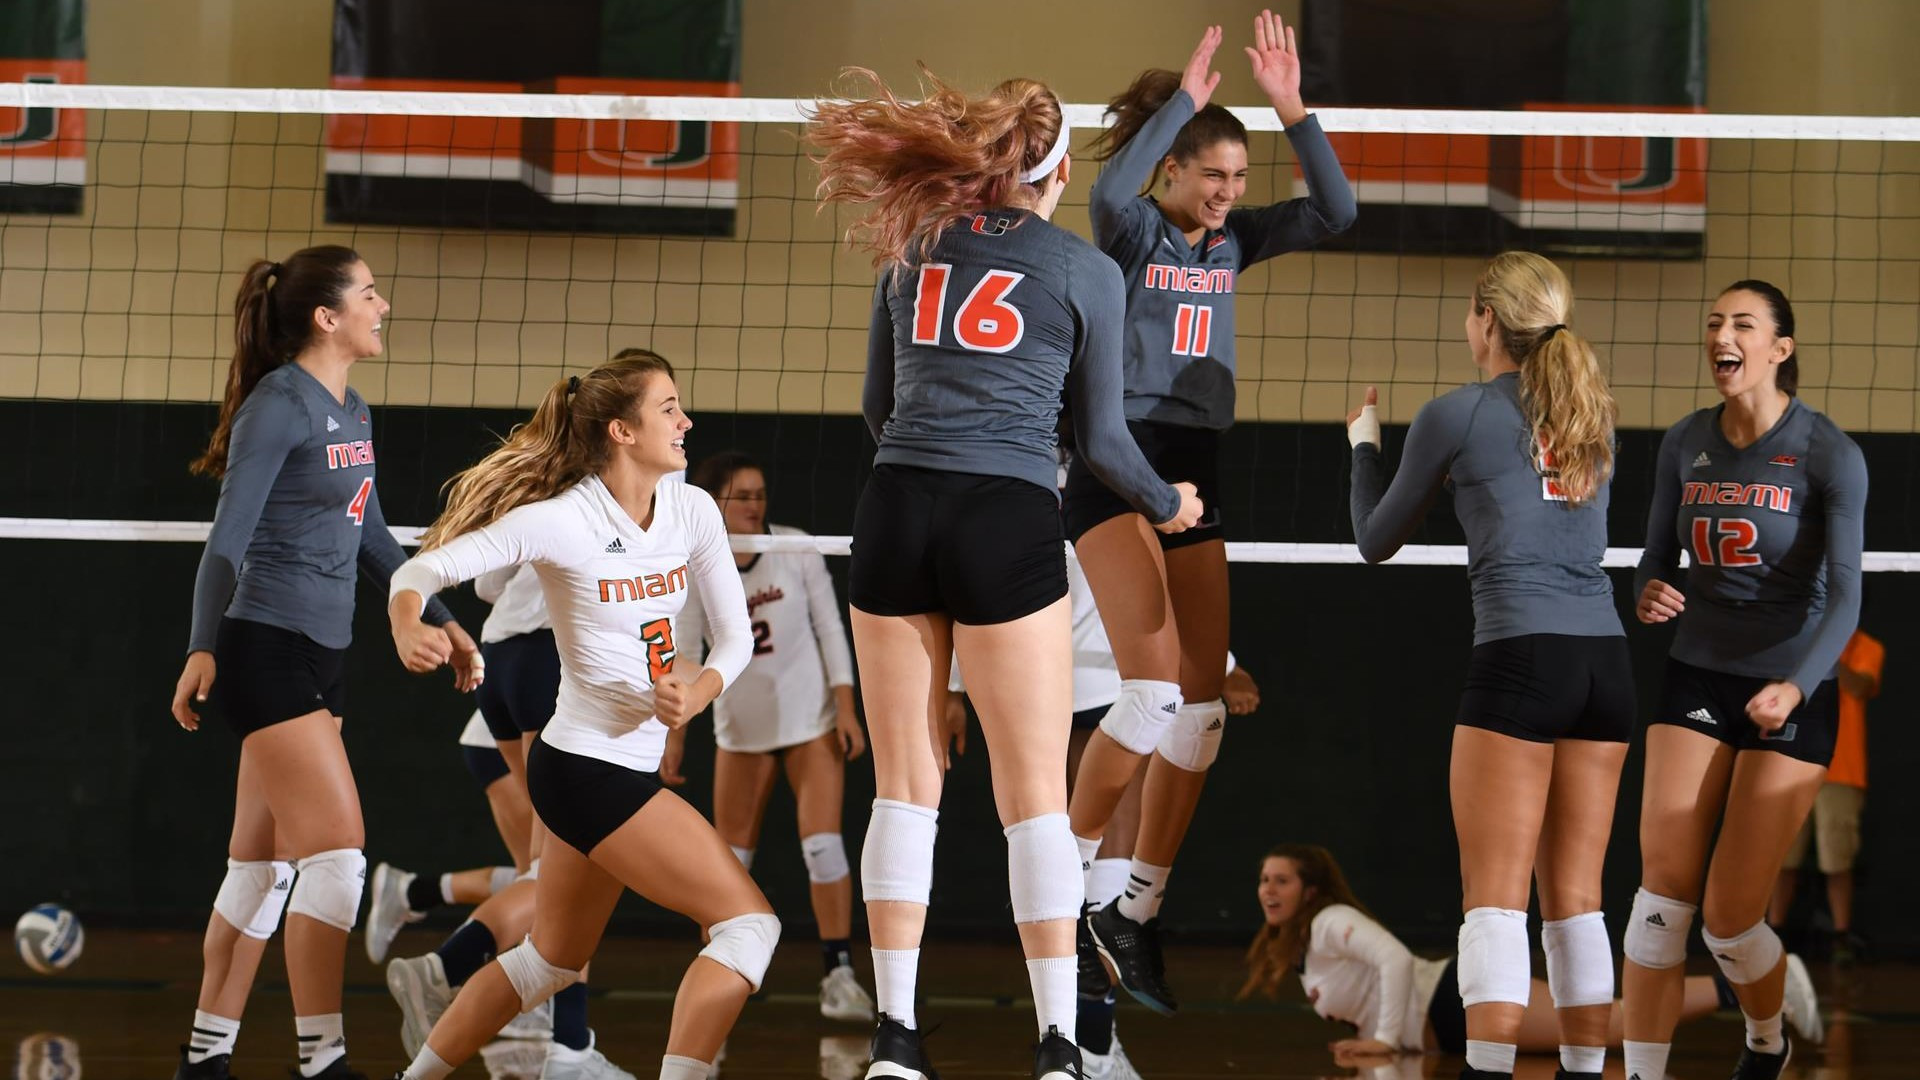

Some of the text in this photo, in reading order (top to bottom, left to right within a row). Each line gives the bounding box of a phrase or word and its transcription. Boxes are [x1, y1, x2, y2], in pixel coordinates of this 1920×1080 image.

[971, 215, 1010, 236] U
[1145, 264, 1234, 294] miam
[912, 263, 1025, 353] 16
[1171, 303, 1212, 357] 11
[346, 477, 373, 526] 4
[1691, 517, 1763, 567] 12
[640, 617, 676, 683] 2
